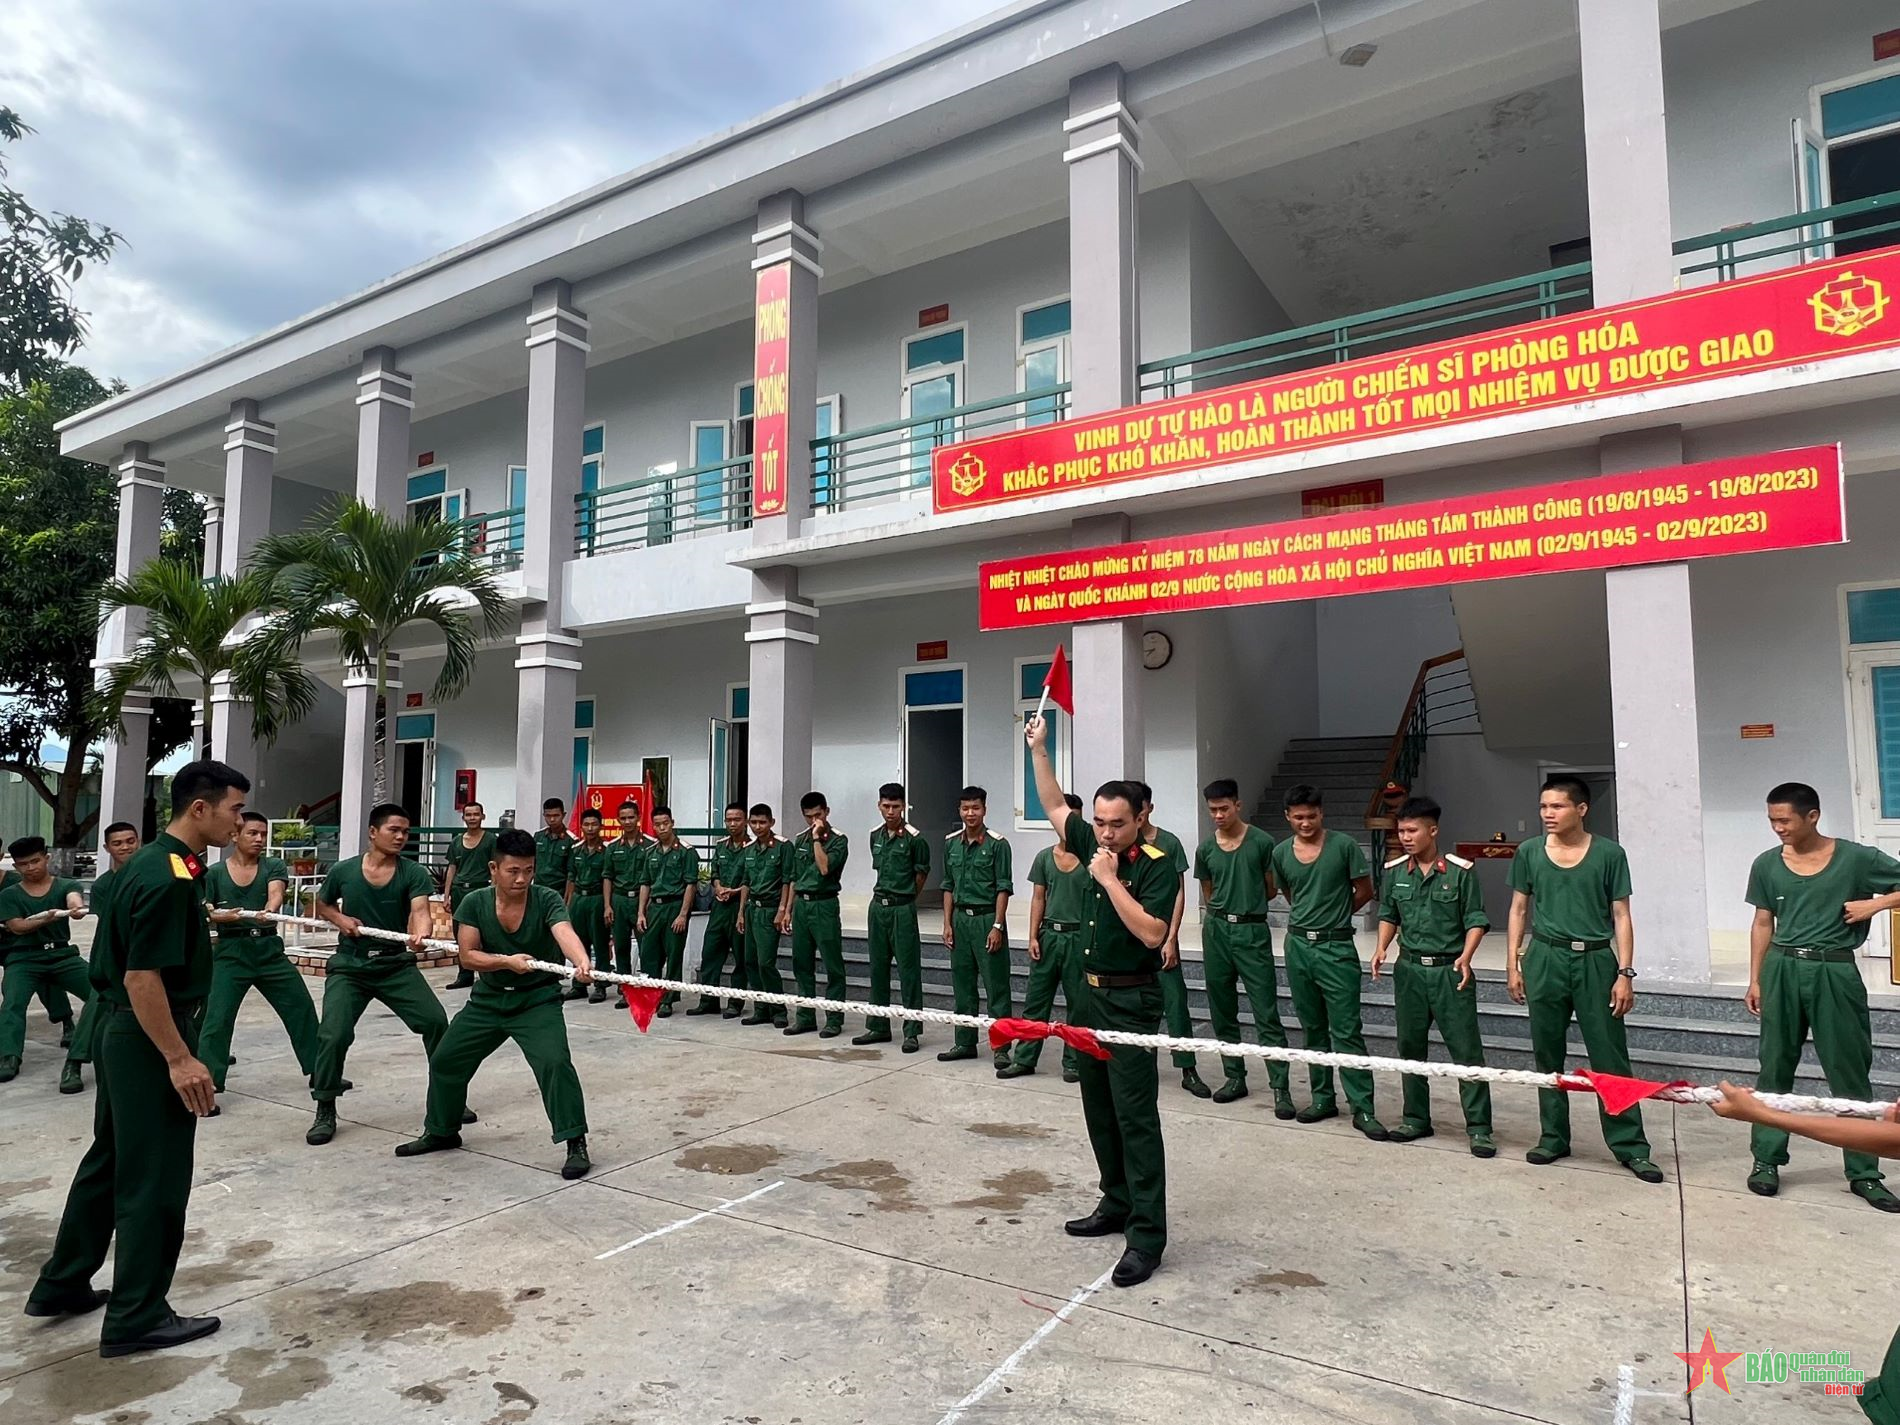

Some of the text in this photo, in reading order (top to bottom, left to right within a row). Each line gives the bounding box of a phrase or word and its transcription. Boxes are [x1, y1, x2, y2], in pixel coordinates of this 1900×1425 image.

[758, 291, 787, 344] PHÒNG
[757, 357, 785, 419] CHỐNG
[1003, 329, 1775, 493] KHẮC PHỤC KHÓ KHĂN, HOÀN THÀNH TỐT MỌI NHIỆM VỤ ĐƯỢC GIAO
[1074, 320, 1639, 453] VINH DỰ TỰ HÀO LÀ NGƯỜI CHIẾN SĨ PHÒNG HÓA
[761, 432, 778, 493] TỐT
[989, 570, 1021, 591] NHIỆT
[1023, 565, 1056, 587] NHIỆT
[1058, 561, 1089, 581] CHÀO
[1093, 556, 1129, 577] MỪNG
[1132, 549, 1149, 573] KỶ
[1151, 549, 1185, 571] NIỆM
[1188, 548, 1204, 565] 78
[1207, 542, 1239, 563] NĂM
[1243, 537, 1280, 559] NGÀY
[1284, 533, 1323, 553] CÁCH
[1326, 526, 1372, 551] MẠNG
[1376, 518, 1427, 542] THÁNG
[1431, 512, 1467, 535] TÁM
[1472, 505, 1528, 529] THÀNH
[1533, 497, 1582, 521] CÔNG
[1587, 484, 1688, 517] (19/8/1945
[1708, 466, 1818, 499] 19/8/2023)
[1016, 594, 1031, 613] VÀ
[1034, 592, 1066, 611] NGÀY
[1068, 584, 1101, 608] QUỐC
[1104, 582, 1147, 603] KHÁNH
[1151, 580, 1179, 598] 02/9
[1183, 572, 1220, 595] NƯỚC
[1224, 570, 1264, 594] CỘNG
[1267, 564, 1297, 585] HÒA
[1301, 561, 1322, 582] XÃ
[1325, 558, 1352, 581] HỘI
[1355, 549, 1388, 577] CHỦ
[1392, 548, 1444, 572] NGHĨA
[1447, 542, 1485, 567] VIỆT
[1489, 538, 1531, 561] NAM
[1537, 526, 1637, 556] (02/9/1945
[1656, 511, 1767, 541] 02/9/2023)
